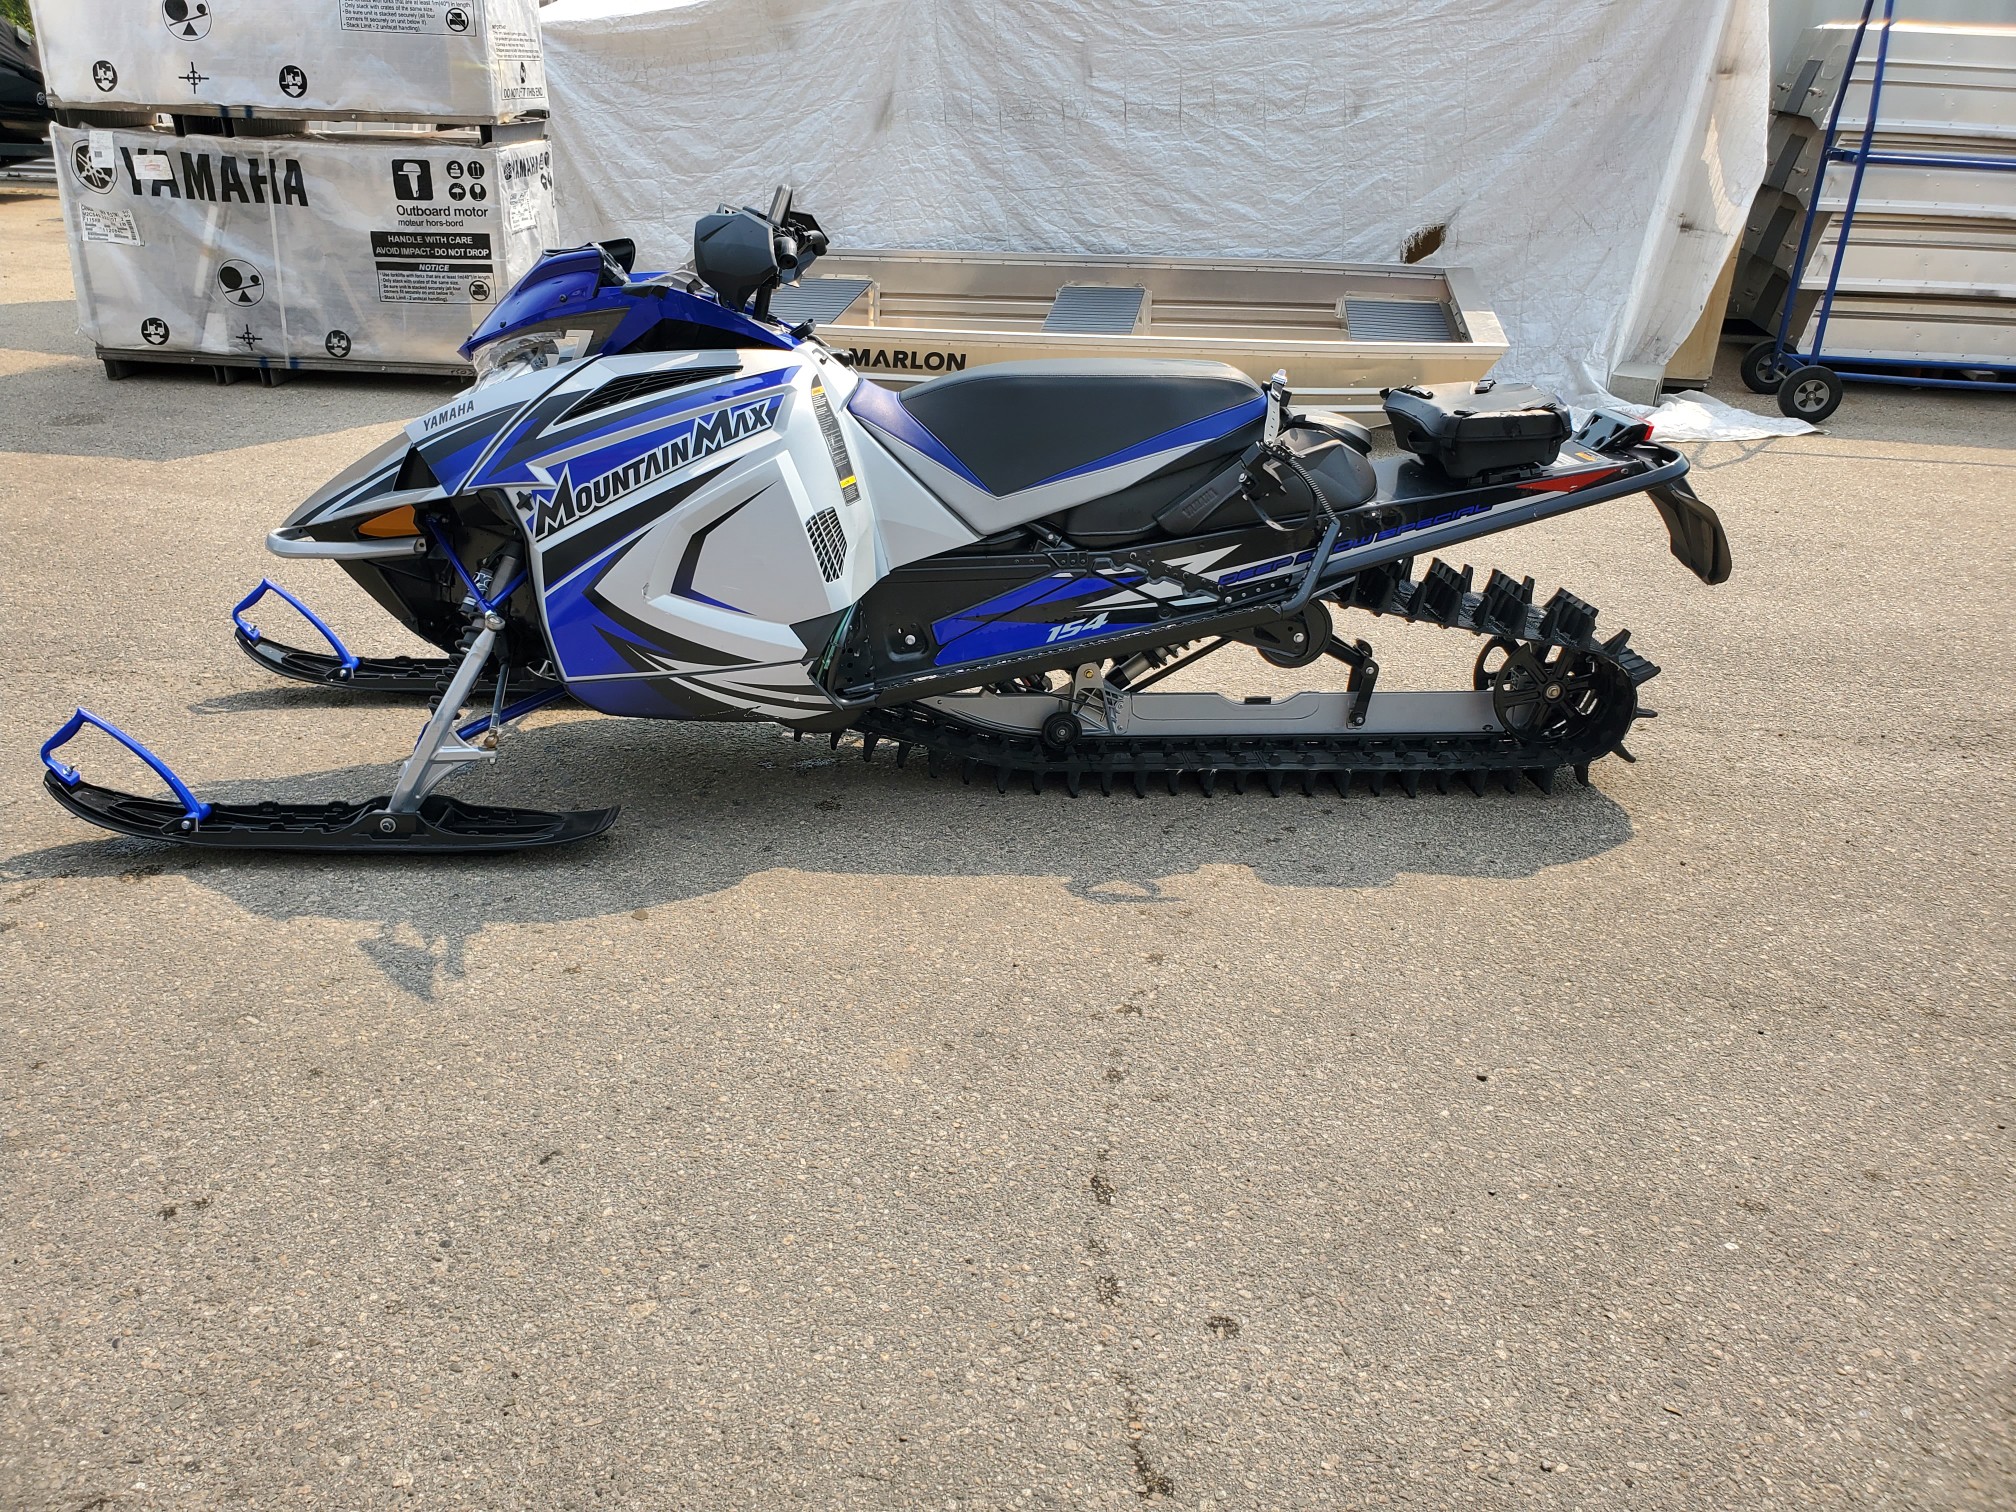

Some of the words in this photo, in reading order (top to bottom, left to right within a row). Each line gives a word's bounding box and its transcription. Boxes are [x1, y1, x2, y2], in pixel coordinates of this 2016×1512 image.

[396, 204, 451, 216] Outboard
[454, 206, 488, 218] motor
[426, 219, 464, 227] hors-bord
[376, 246, 400, 254] AVOID
[449, 248, 465, 256] NOT
[466, 248, 489, 257] DROP
[388, 235, 423, 244] HANDLE
[424, 236, 447, 244] WITH
[848, 348, 966, 372] MARLON
[423, 400, 475, 432] YAMAHA
[534, 434, 690, 538] MOUNTAIN
[692, 398, 772, 457] MAX
[1218, 556, 1294, 586] DEEP
[1296, 535, 1373, 564] SOW
[1376, 504, 1490, 540] SPECIAL
[1046, 612, 1110, 643] 154
